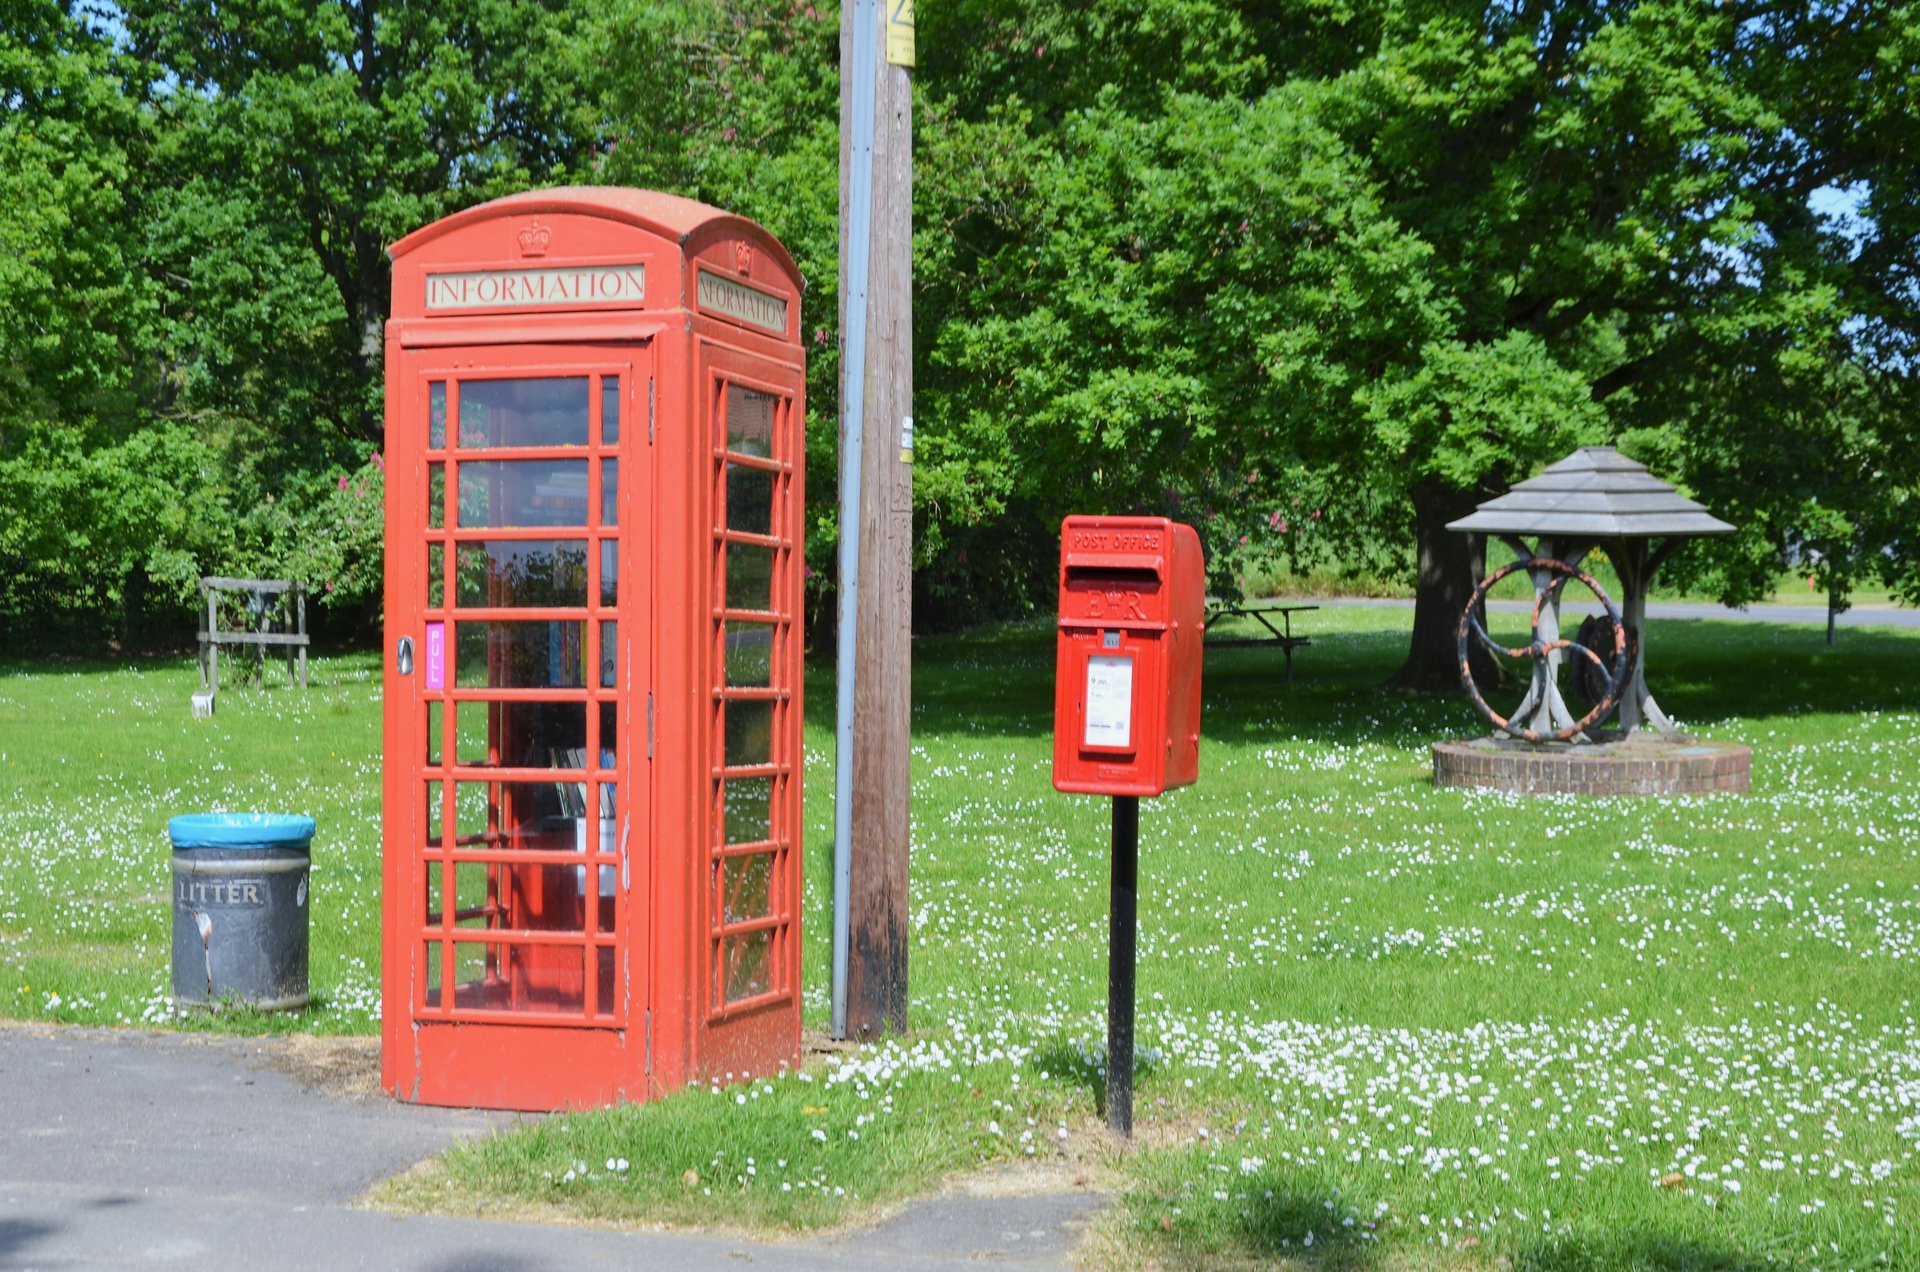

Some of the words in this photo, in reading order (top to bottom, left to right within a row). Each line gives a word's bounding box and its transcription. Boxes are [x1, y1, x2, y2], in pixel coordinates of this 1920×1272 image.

[431, 270, 644, 304] INFORMATION
[699, 278, 785, 327] NFORMATION
[1073, 533, 1107, 549] POST
[1112, 533, 1160, 550] OFFICE
[431, 630, 440, 683] PULL
